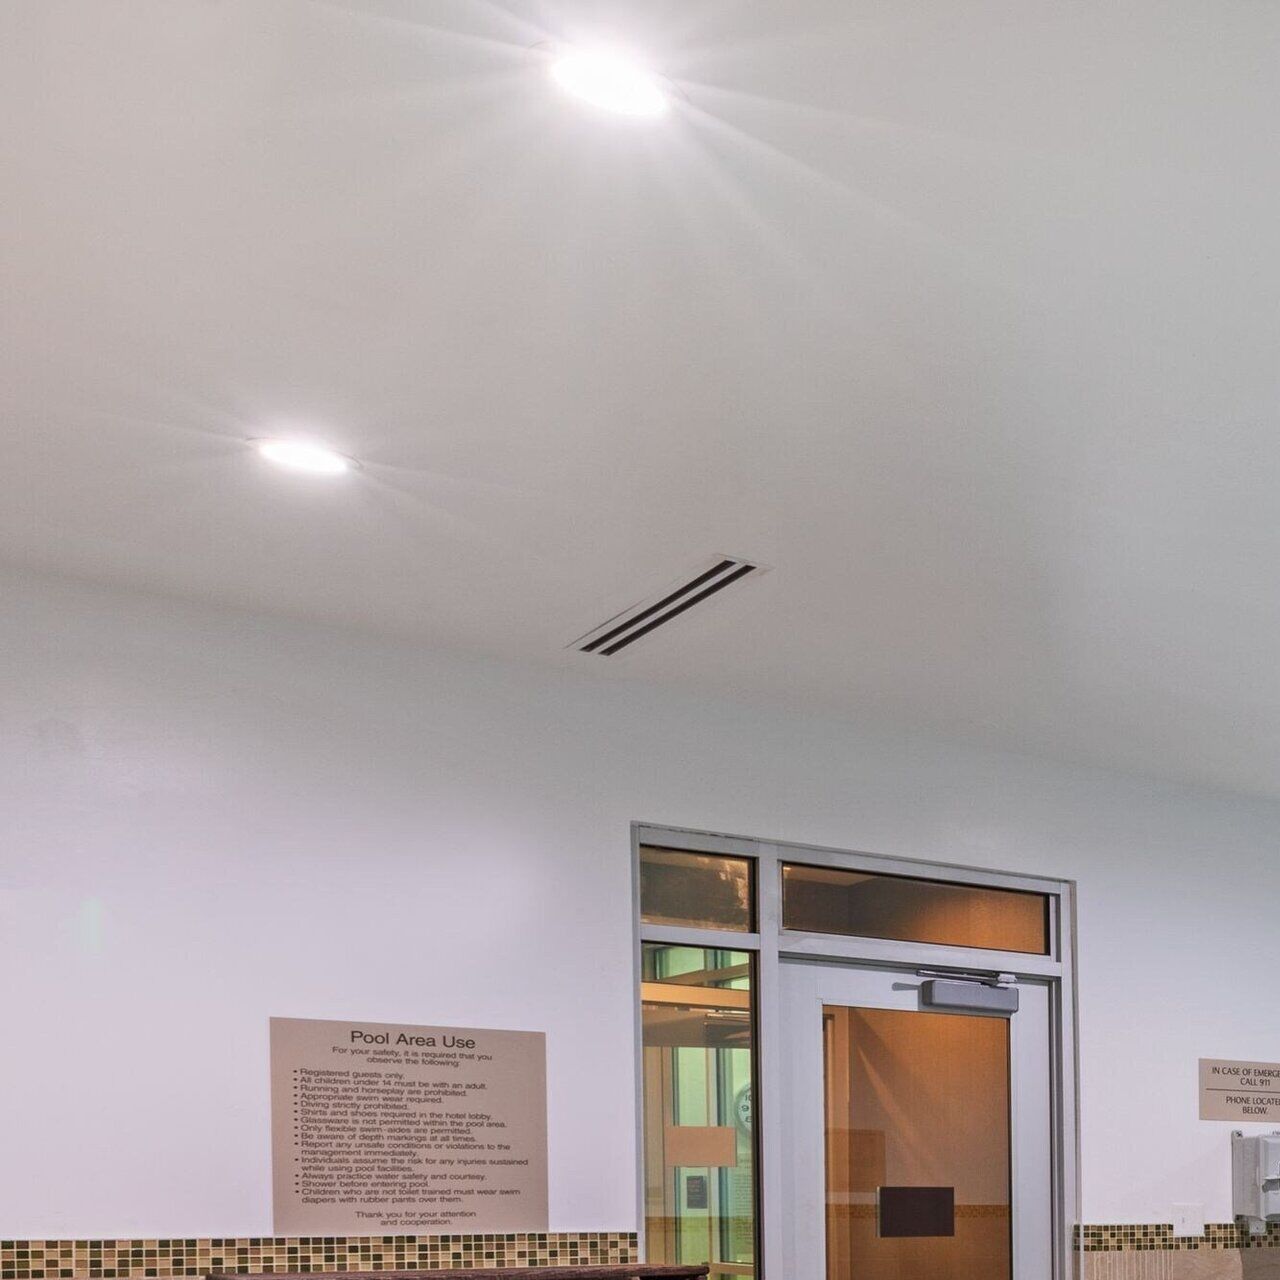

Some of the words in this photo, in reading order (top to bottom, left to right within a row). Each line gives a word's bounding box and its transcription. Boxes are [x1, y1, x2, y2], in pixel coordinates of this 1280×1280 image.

[351, 1030, 390, 1044] Pool
[396, 1033, 436, 1046] Area
[442, 1036, 476, 1049] Use
[350, 1048, 370, 1056] your
[421, 1050, 456, 1060] required
[300, 1068, 350, 1078] Registered
[352, 1070, 382, 1079] guests
[1240, 1078, 1257, 1086] CALL
[300, 1084, 339, 1094] Running
[361, 1086, 405, 1096] horseplay
[1226, 1096, 1250, 1104] PHONE
[300, 1101, 330, 1109] Diving
[380, 1110, 416, 1119] required
[465, 1120, 484, 1129] pool
[359, 1134, 384, 1142] depth
[301, 1140, 333, 1149] Report
[370, 1181, 407, 1189] entering
